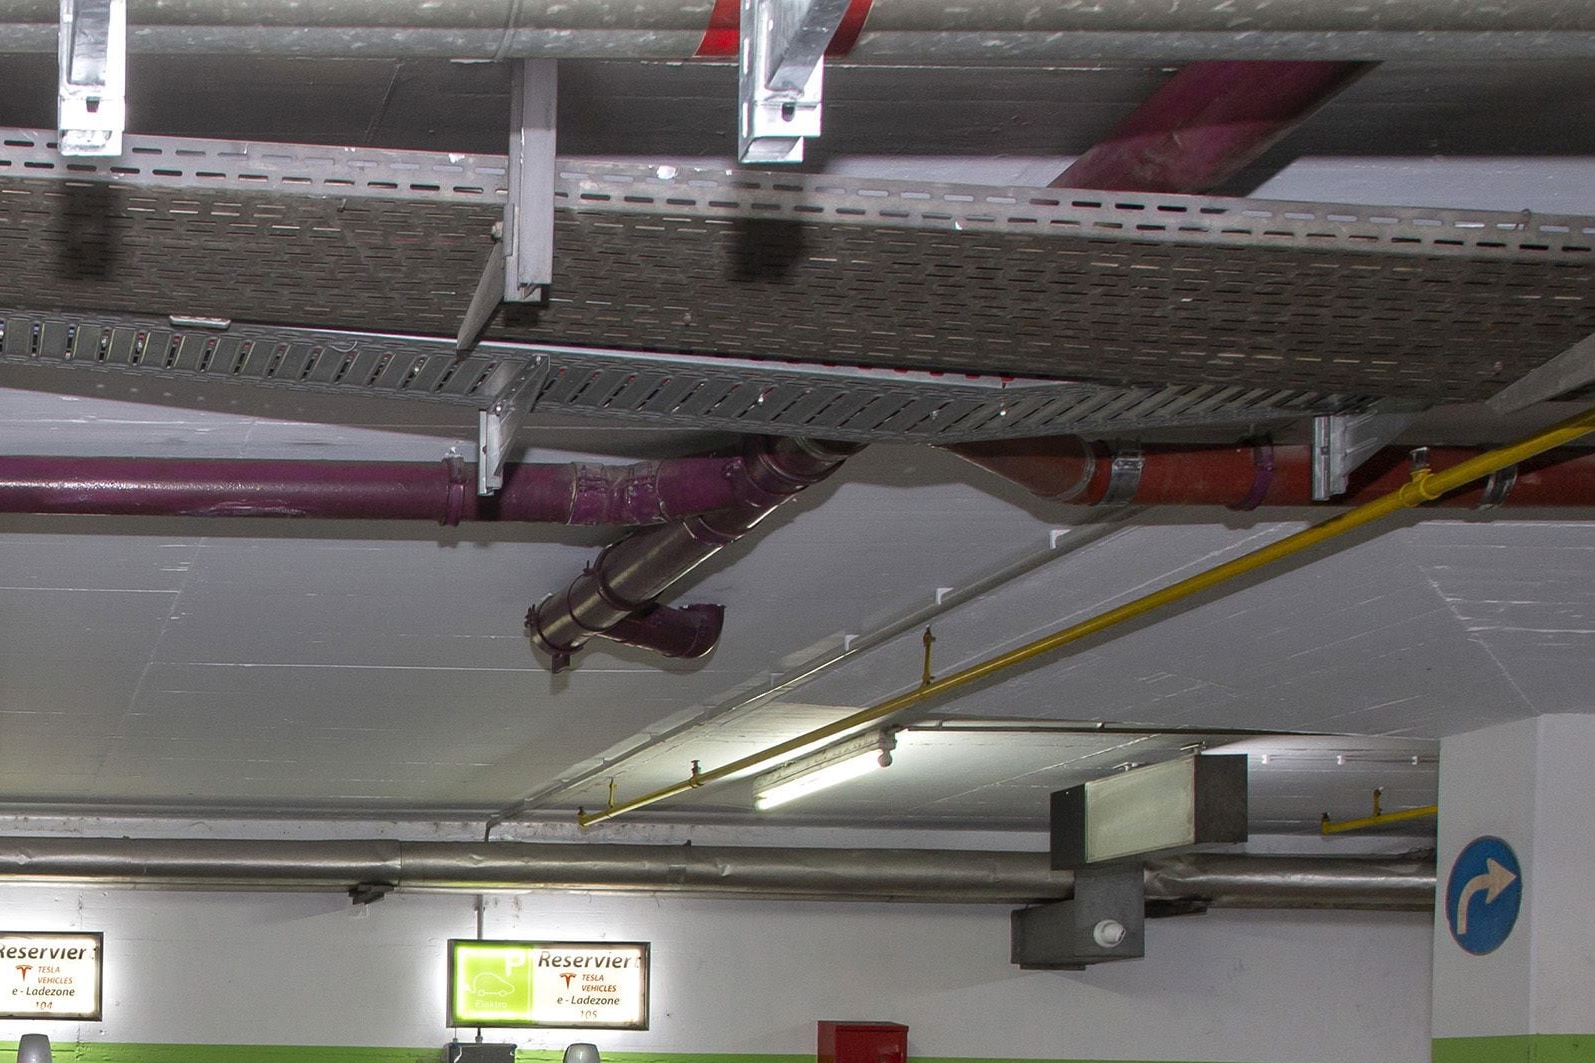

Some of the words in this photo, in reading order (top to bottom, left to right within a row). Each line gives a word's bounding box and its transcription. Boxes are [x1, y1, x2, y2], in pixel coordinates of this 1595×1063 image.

[26, 987, 75, 996] Ladezone
[571, 995, 620, 1005] Ladezone
[35, 1001, 53, 1010] 104
